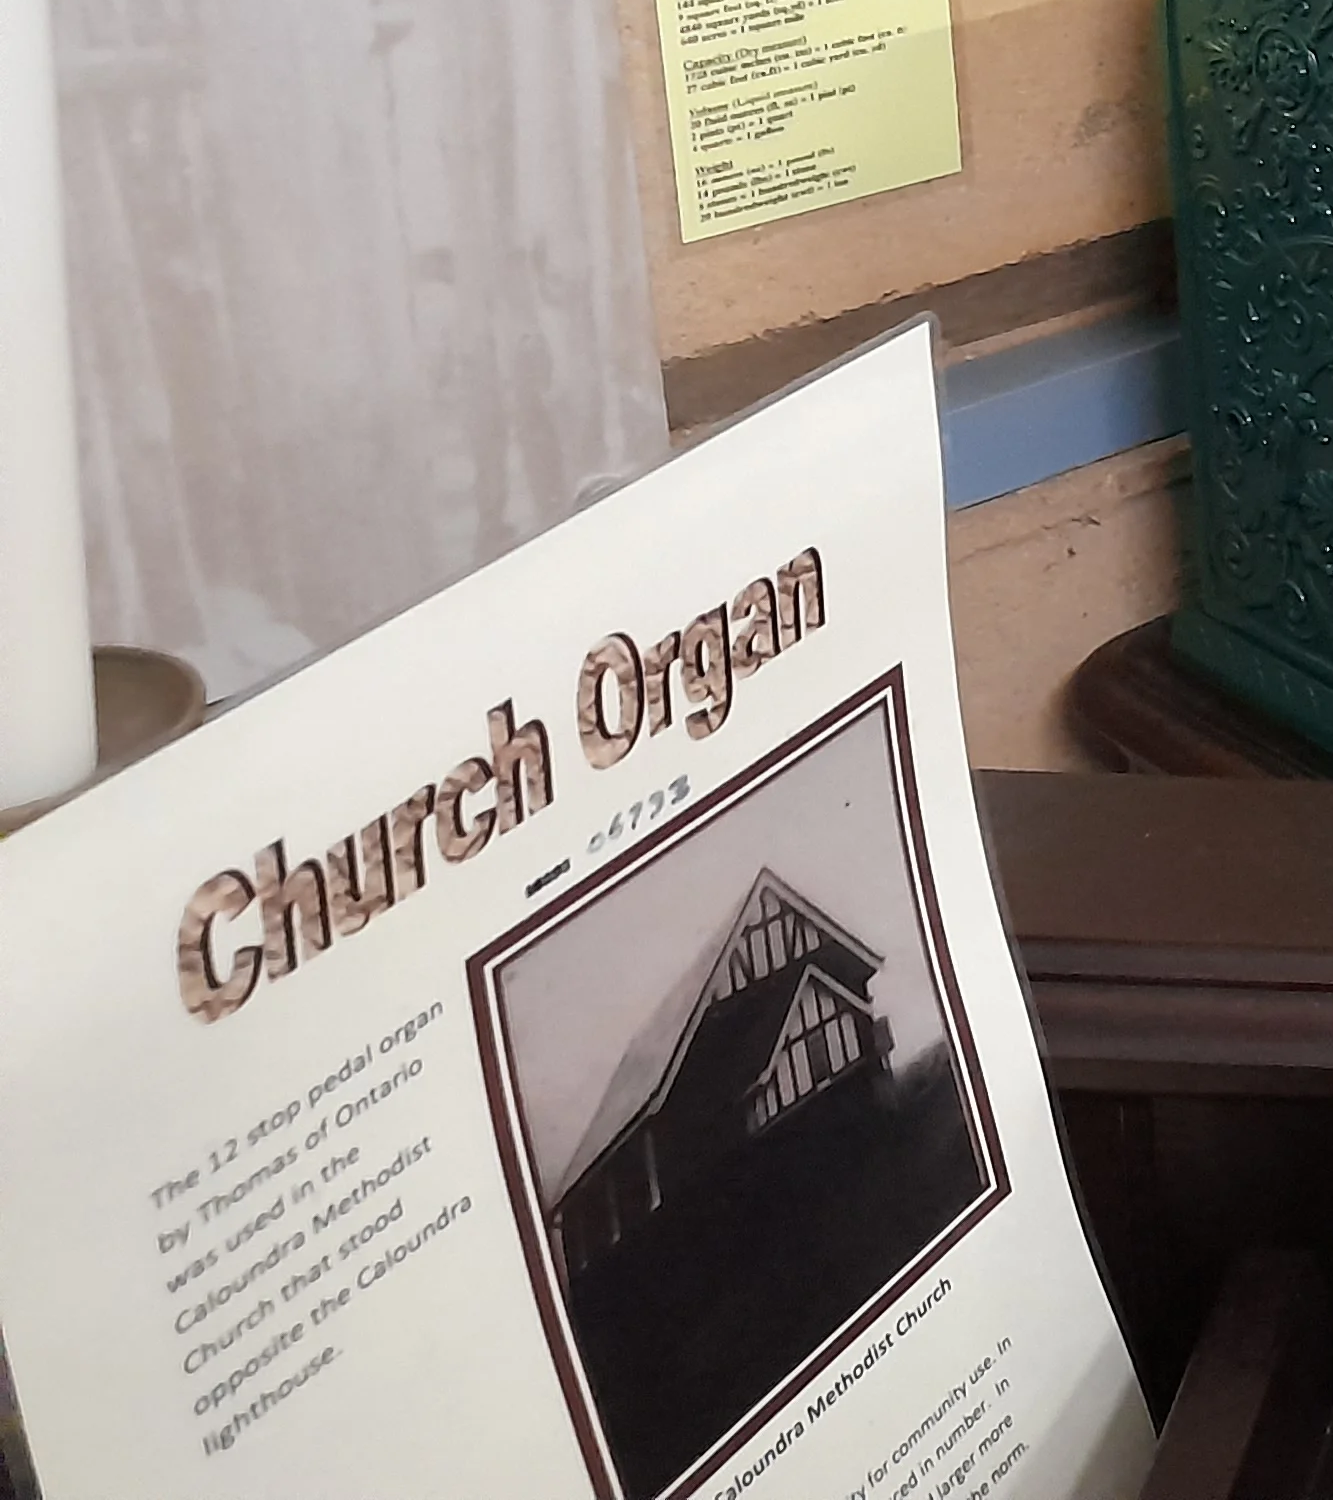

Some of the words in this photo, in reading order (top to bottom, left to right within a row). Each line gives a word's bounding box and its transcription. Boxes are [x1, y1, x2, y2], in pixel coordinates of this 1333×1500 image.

[178, 697, 554, 1025] Church
[577, 546, 826, 771] Organ
[151, 1170, 201, 1209] The
[208, 1139, 239, 1174] 12
[246, 1100, 301, 1146] stop
[308, 1044, 374, 1108] pedal
[378, 1001, 444, 1054] organ
[157, 1222, 191, 1254] by
[197, 1146, 298, 1225] Thomas
[304, 1117, 329, 1151] of
[335, 1058, 424, 1129] Ontario
[166, 1248, 219, 1293] was
[225, 1197, 286, 1253] used
[290, 1176, 315, 1205] in
[319, 1146, 360, 1184] the
[174, 1231, 306, 1334] Caloundra
[311, 1136, 433, 1235] Methodist
[183, 1299, 276, 1375] Church
[280, 1255, 333, 1302] that
[338, 1198, 405, 1260] stood
[193, 1322, 304, 1416] opposite
[310, 1287, 351, 1326] the
[356, 1195, 473, 1289] Caloundra
[806, 1332, 895, 1425] Methodist
[896, 1276, 953, 1337] Church
[202, 1346, 344, 1457] lighthouse.
[867, 1460, 890, 1488] for
[891, 1381, 968, 1465] community
[968, 1355, 998, 1386] use.
[997, 1335, 1013, 1356] In
[918, 1457, 935, 1477] in
[935, 1401, 992, 1460] number.
[994, 1377, 1012, 1397] In
[934, 1452, 977, 1500] larger
[977, 1414, 1014, 1457] more
[990, 1442, 1030, 1485] norm.
